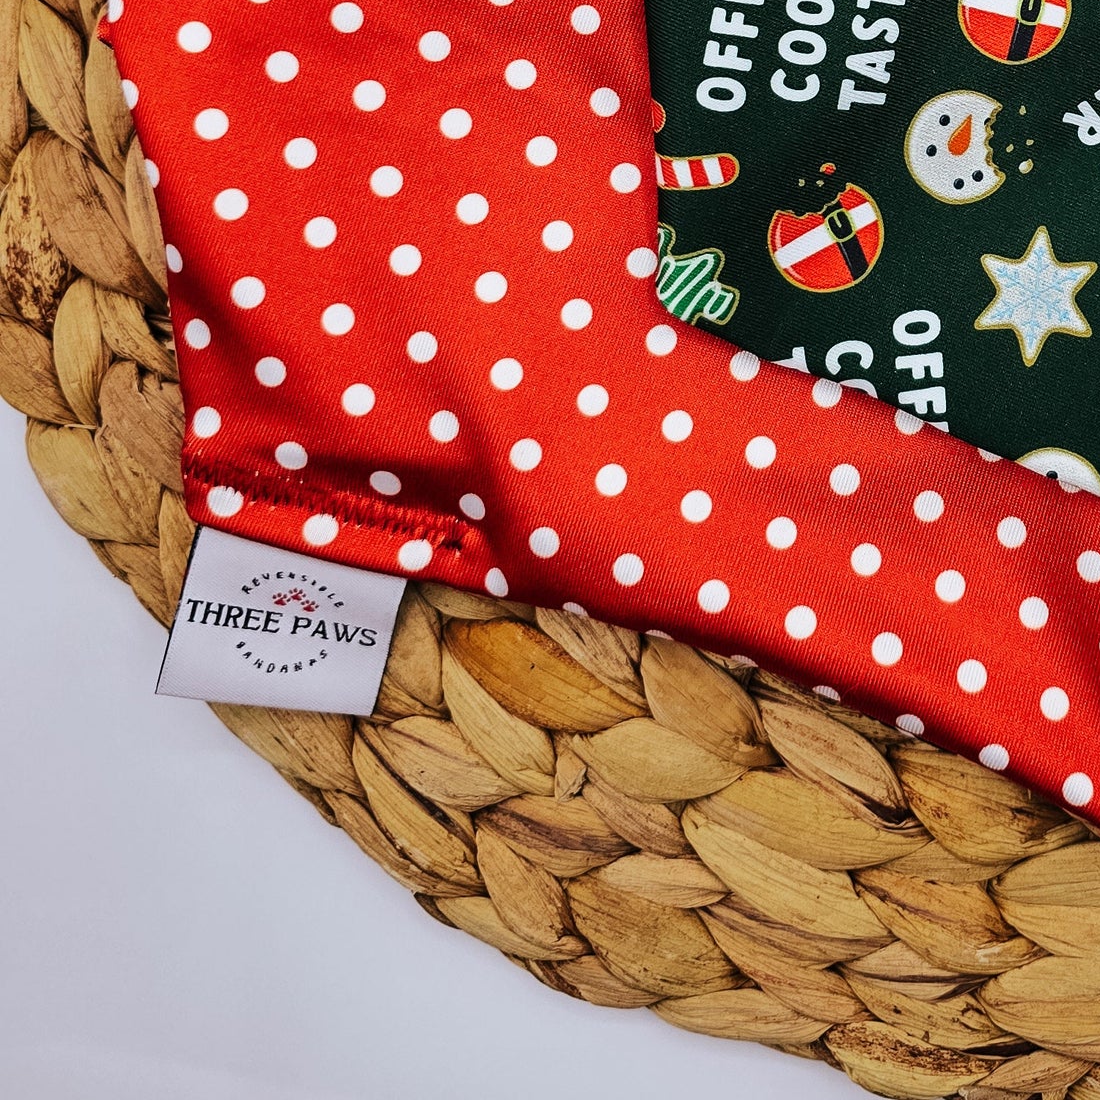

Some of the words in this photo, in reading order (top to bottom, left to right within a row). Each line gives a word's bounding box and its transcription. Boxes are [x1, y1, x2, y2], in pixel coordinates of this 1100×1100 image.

[241, 571, 345, 609] REVERSIBLE
[186, 598, 284, 635] THREE
[290, 615, 378, 648] PAWS
[236, 640, 328, 674] BANDANAS
